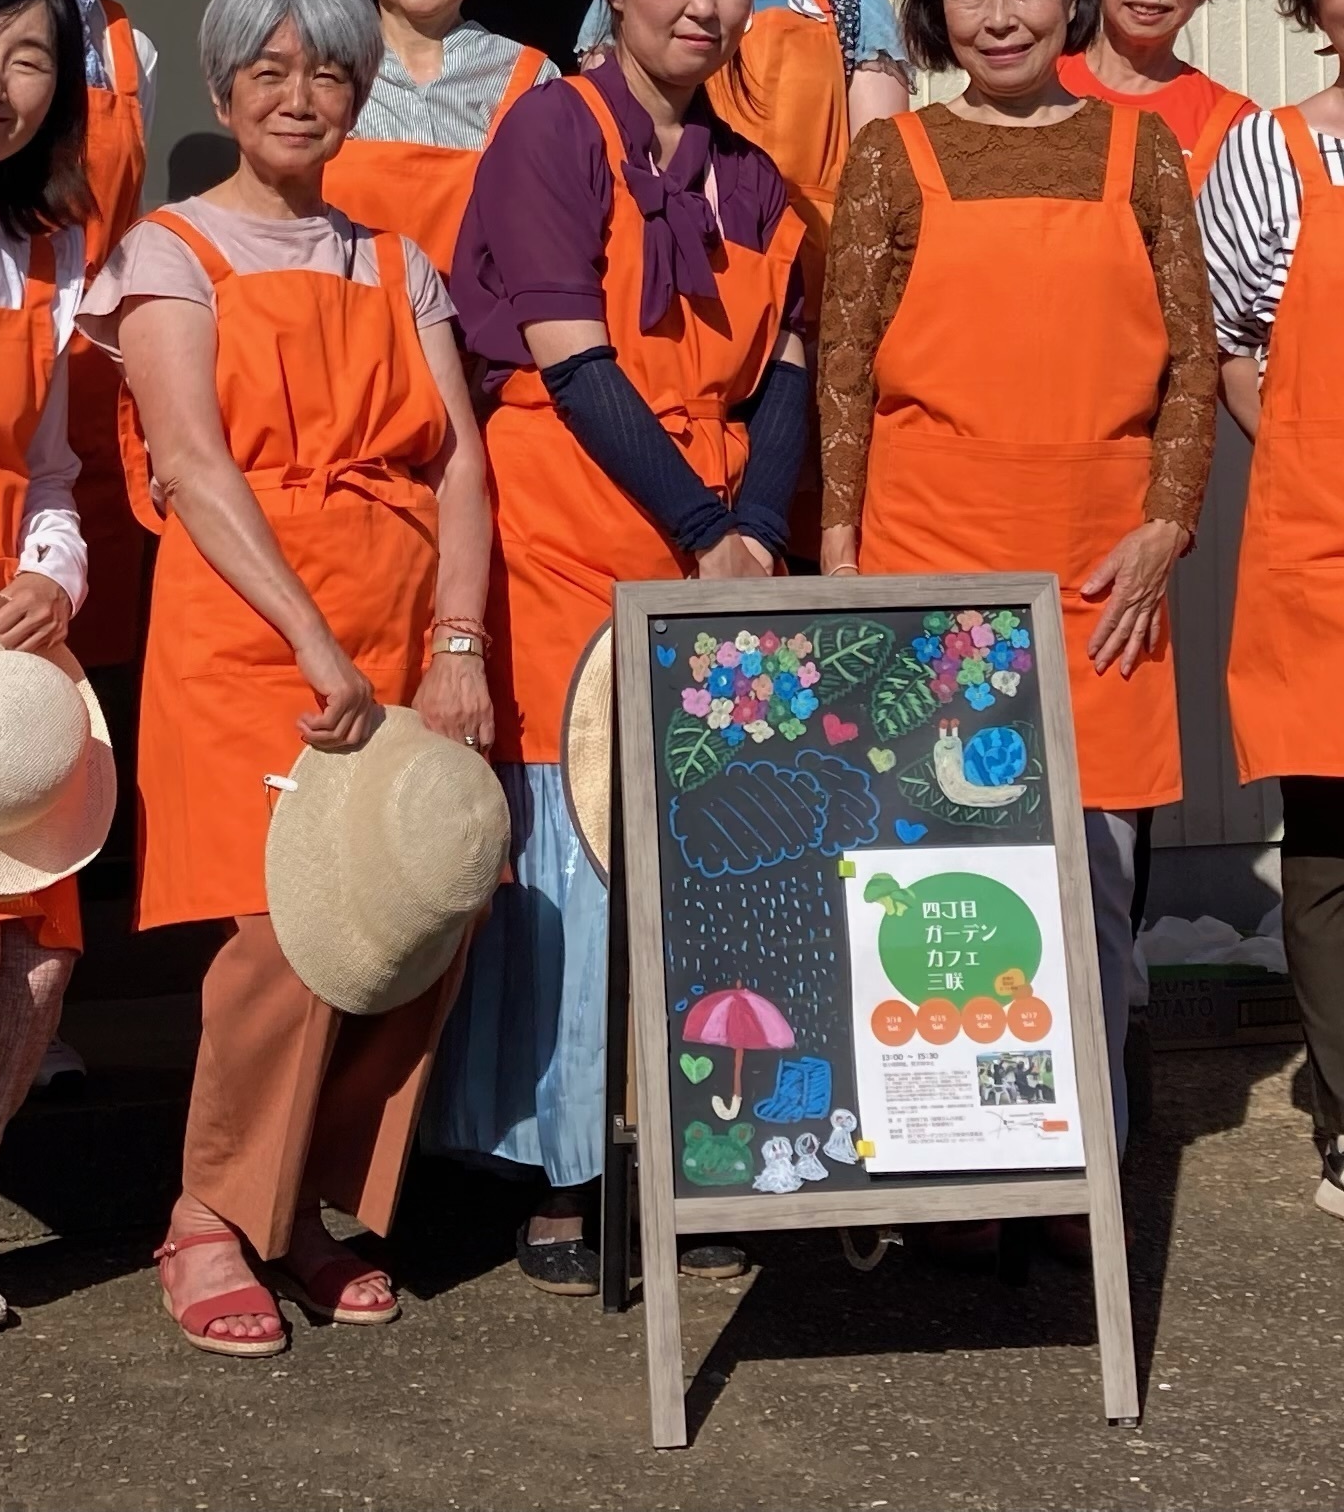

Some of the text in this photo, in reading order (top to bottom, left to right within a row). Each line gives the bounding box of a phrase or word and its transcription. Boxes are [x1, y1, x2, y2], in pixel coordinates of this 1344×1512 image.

[922, 900, 977, 919] 四丁目
[925, 924, 997, 944] ガーデン
[927, 949, 980, 968] カフェ
[927, 972, 964, 991] 三咲
